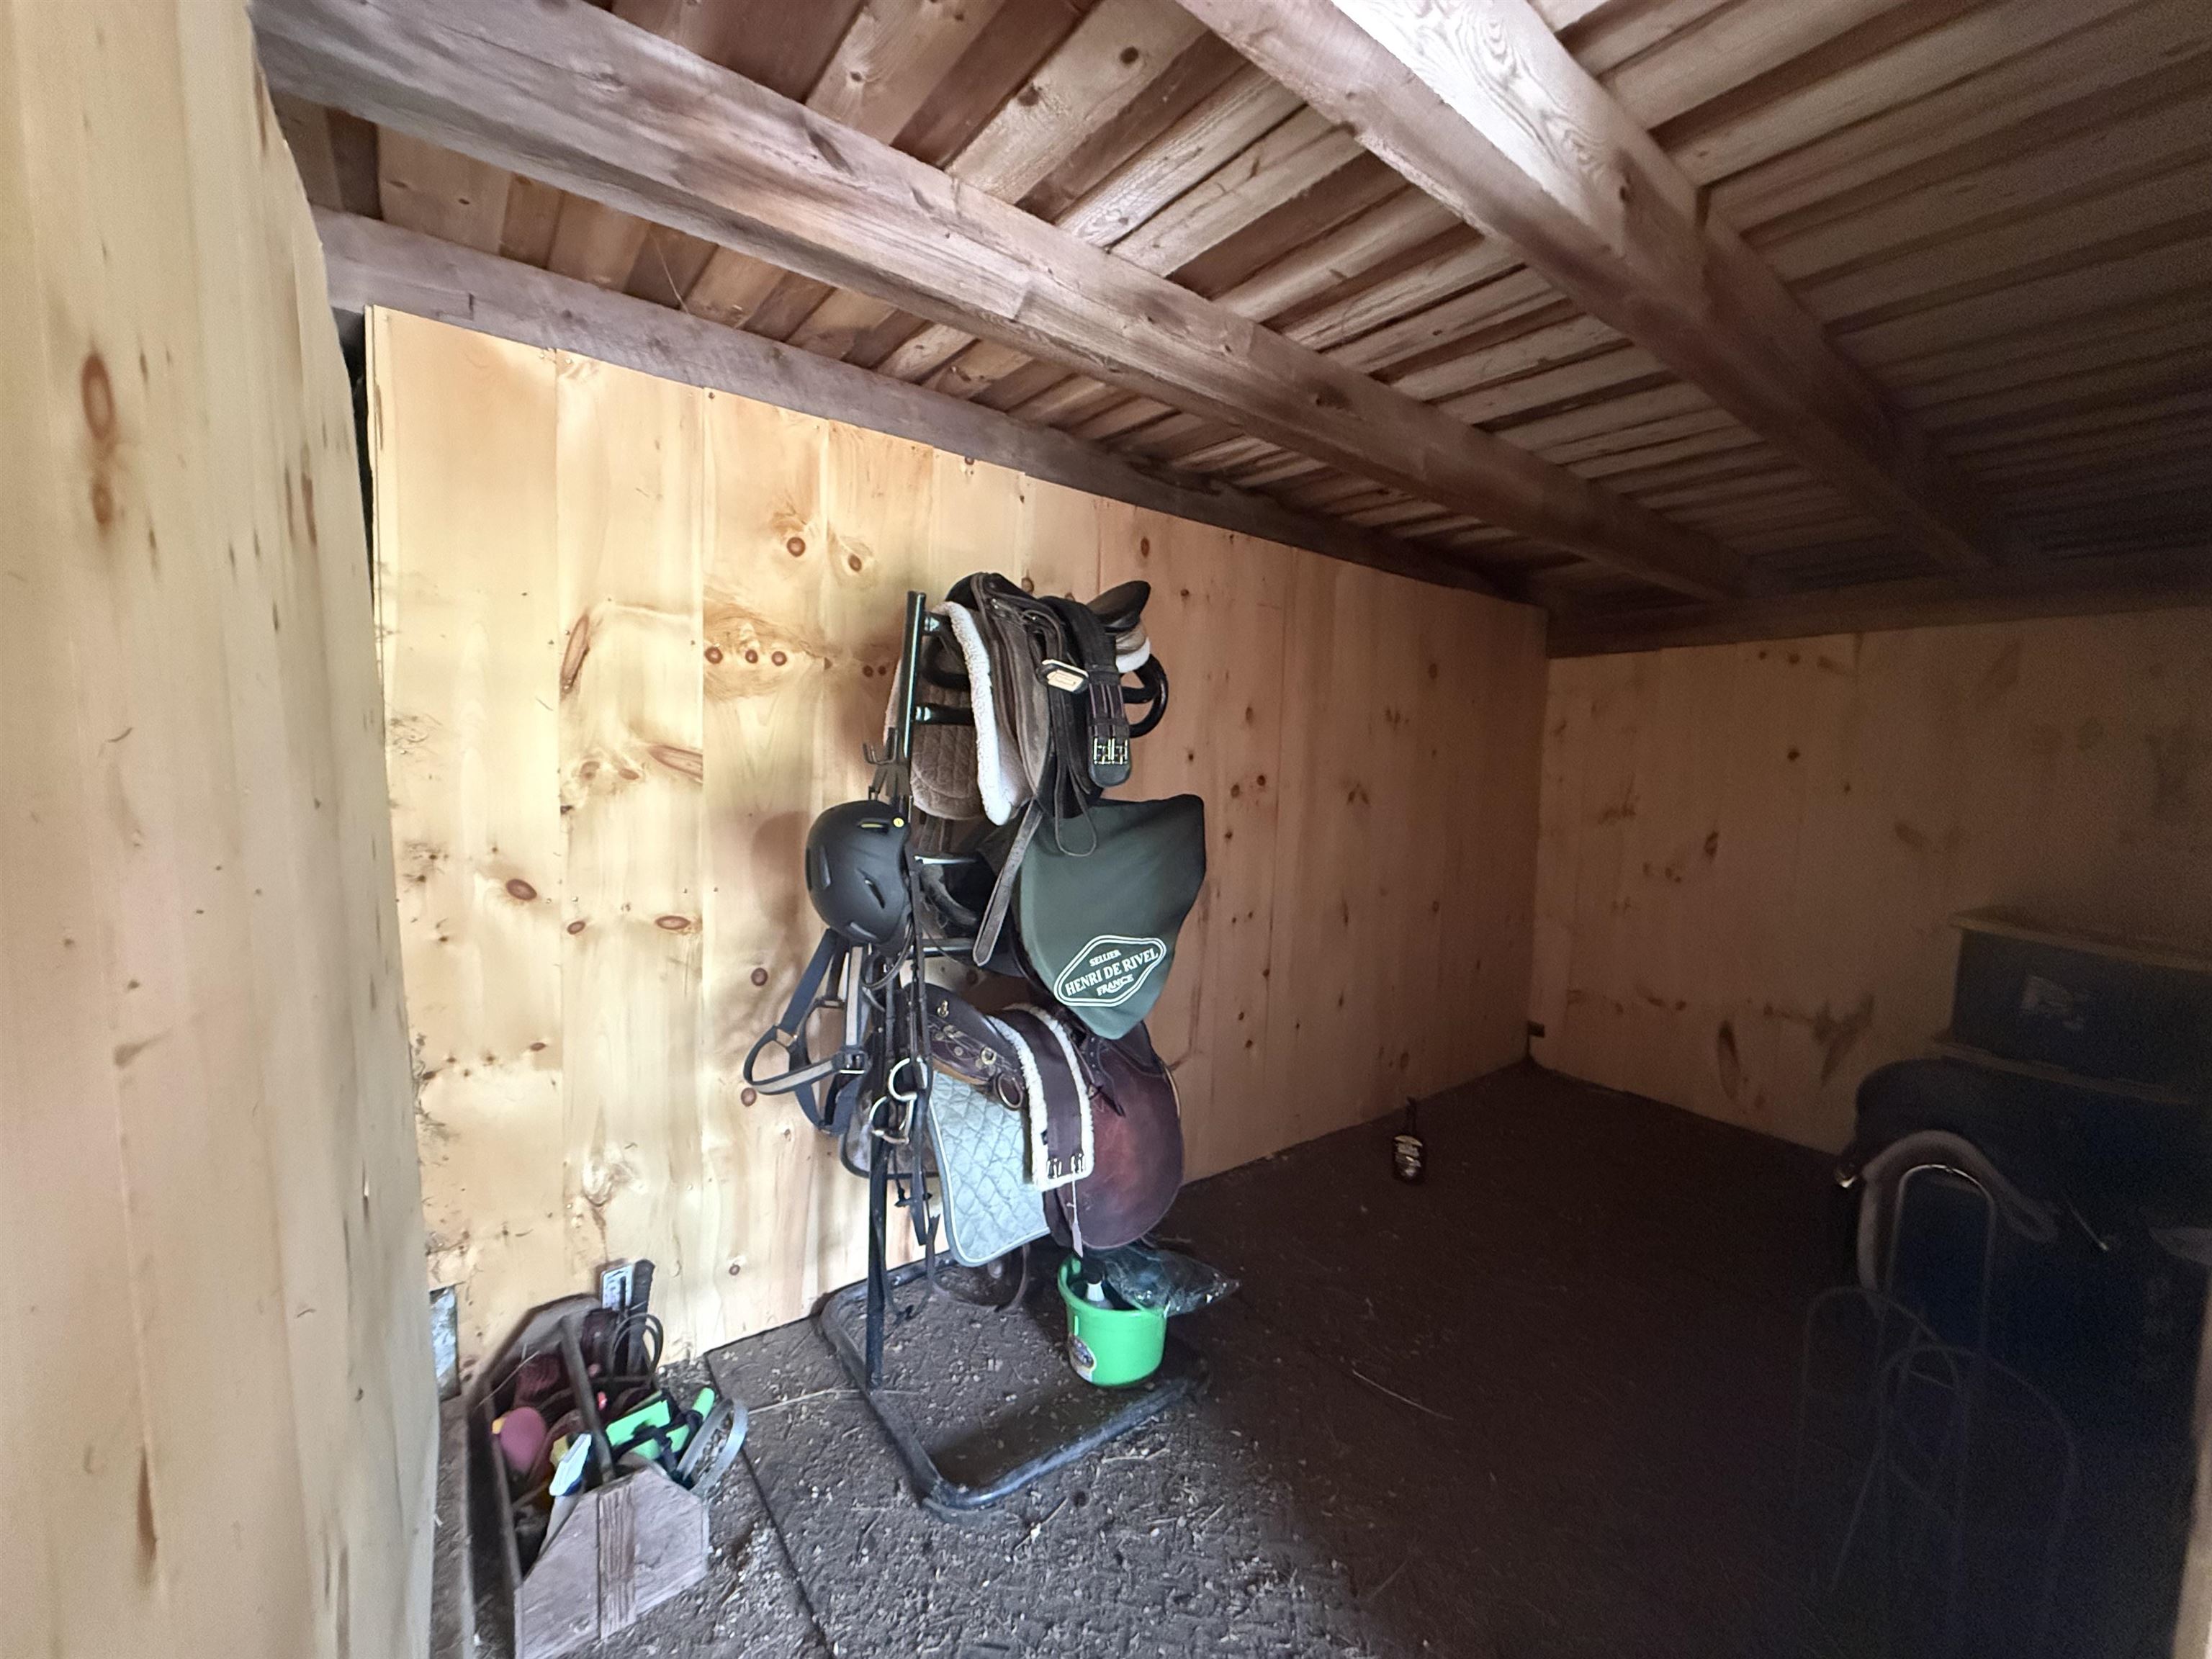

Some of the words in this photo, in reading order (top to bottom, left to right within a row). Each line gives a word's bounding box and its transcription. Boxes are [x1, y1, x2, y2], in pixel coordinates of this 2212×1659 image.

[1089, 949, 1122, 967] SELLIER
[1064, 969, 1103, 997] HENRI
[1102, 962, 1123, 980] DE
[1121, 948, 1159, 973] RIVEL
[1096, 974, 1135, 997] FRANCE
